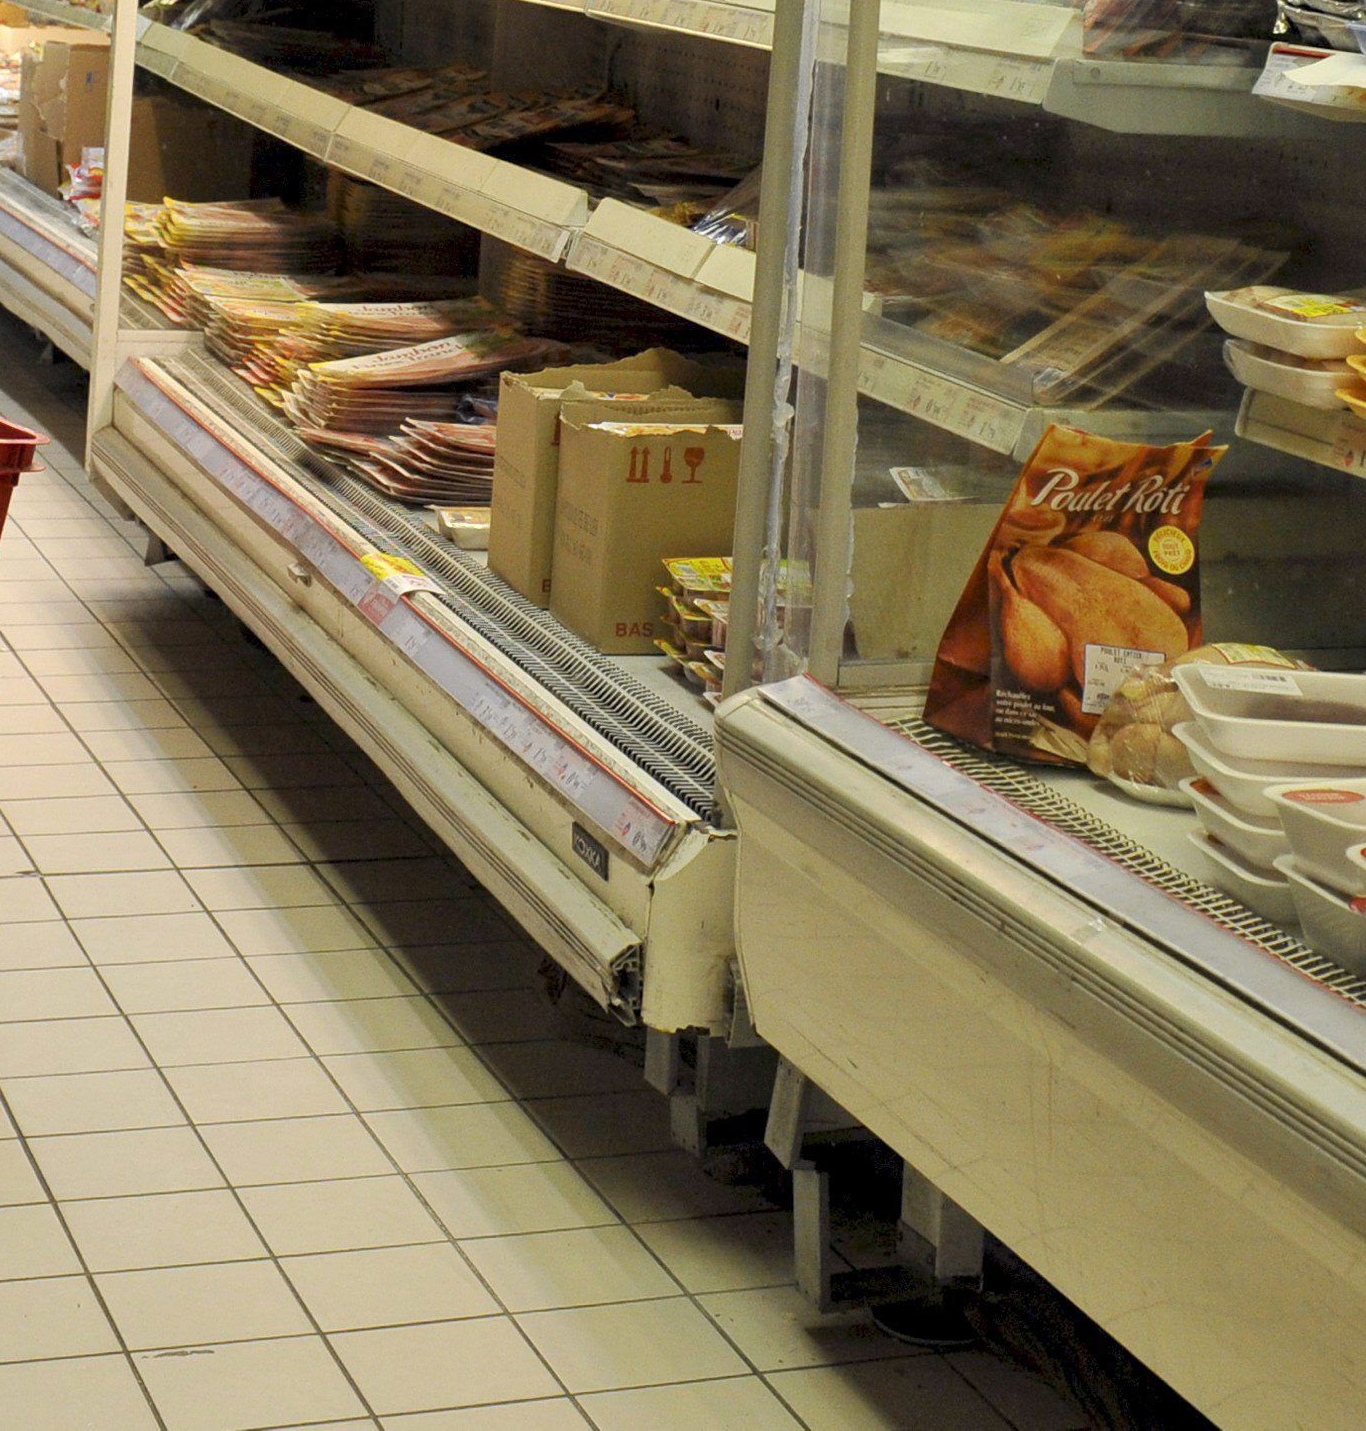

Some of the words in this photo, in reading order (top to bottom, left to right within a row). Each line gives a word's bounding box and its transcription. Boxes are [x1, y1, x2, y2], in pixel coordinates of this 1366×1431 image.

[1030, 467, 1132, 514] Poulet
[1125, 474, 1192, 516] Rôti
[615, 622, 654, 638] BAS
